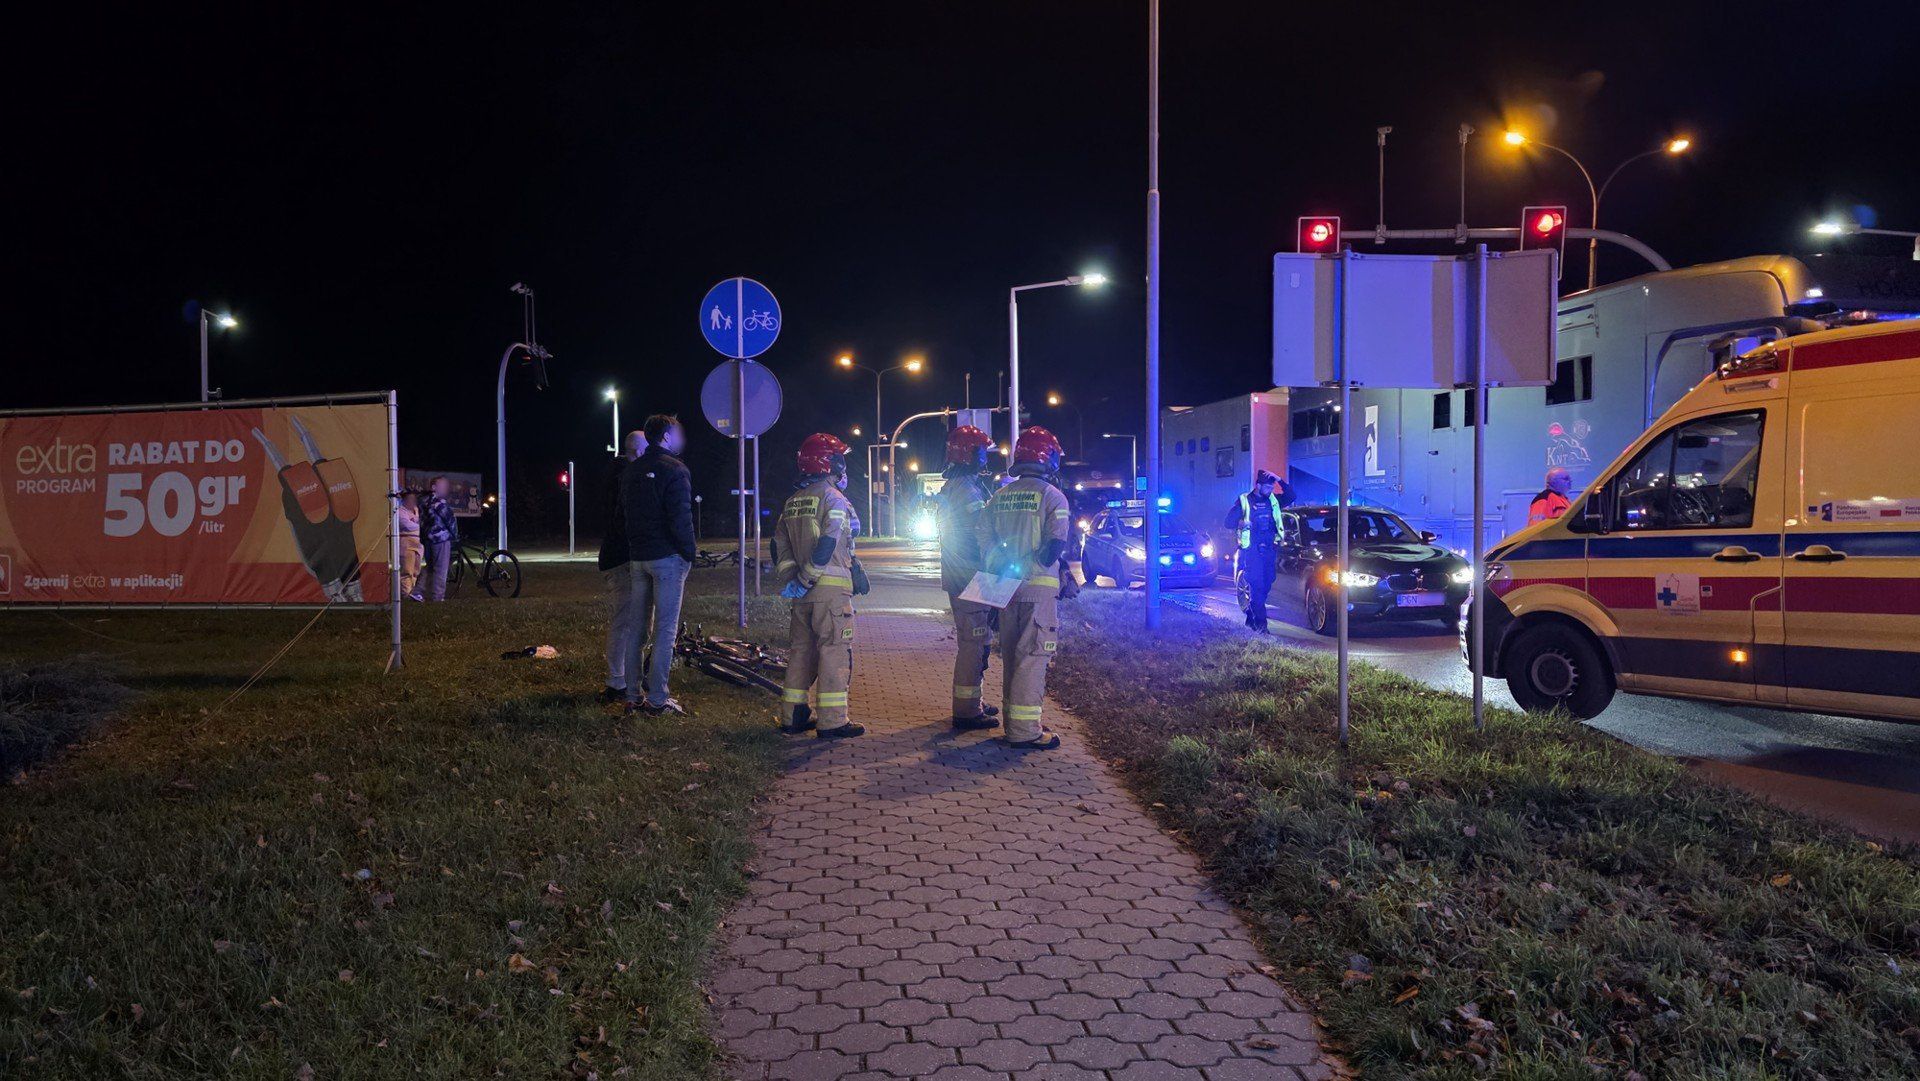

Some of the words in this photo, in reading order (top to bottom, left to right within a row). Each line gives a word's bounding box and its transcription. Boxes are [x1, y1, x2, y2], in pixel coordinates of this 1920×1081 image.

[16, 437, 97, 475] extra
[108, 440, 200, 466] RABAT
[204, 439, 245, 463] DO
[16, 479, 96, 495] PROGRAM
[329, 481, 353, 495] miles
[103, 471, 196, 538] 50
[198, 475, 246, 517] gr
[199, 521, 225, 534] /litr
[24, 575, 69, 590] Zgarnij
[73, 573, 105, 589] extra
[110, 579, 121, 588] w
[124, 574, 184, 591] aplikacji!
[1402, 595, 1418, 604] PGN
